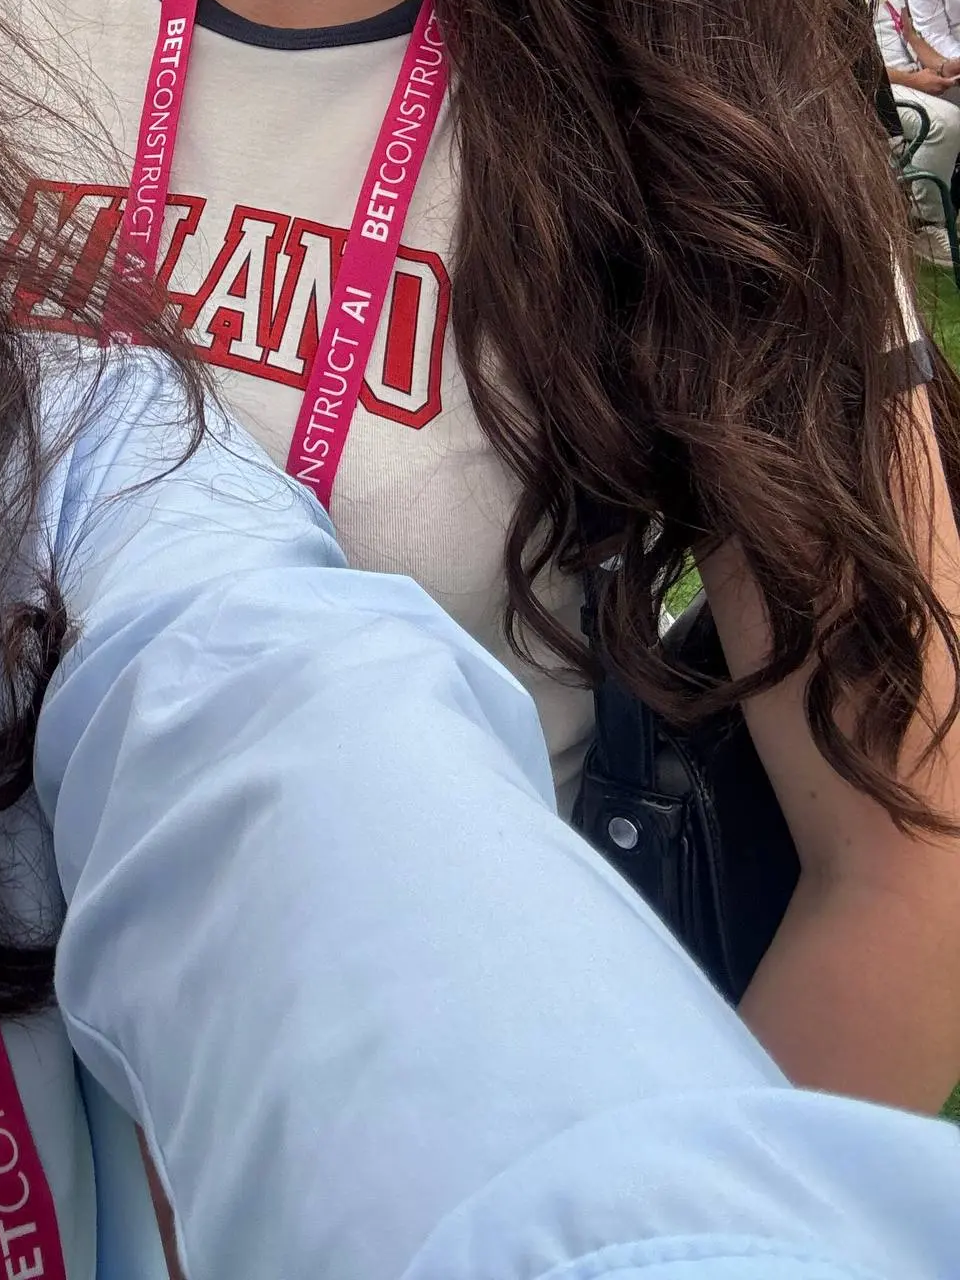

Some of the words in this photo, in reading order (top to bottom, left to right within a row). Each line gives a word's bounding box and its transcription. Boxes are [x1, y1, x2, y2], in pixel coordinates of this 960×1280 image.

[129, 19, 186, 244] BETCONSTRUCT
[296, 327, 359, 496] NSTRUCT
[341, 285, 372, 324] AI
